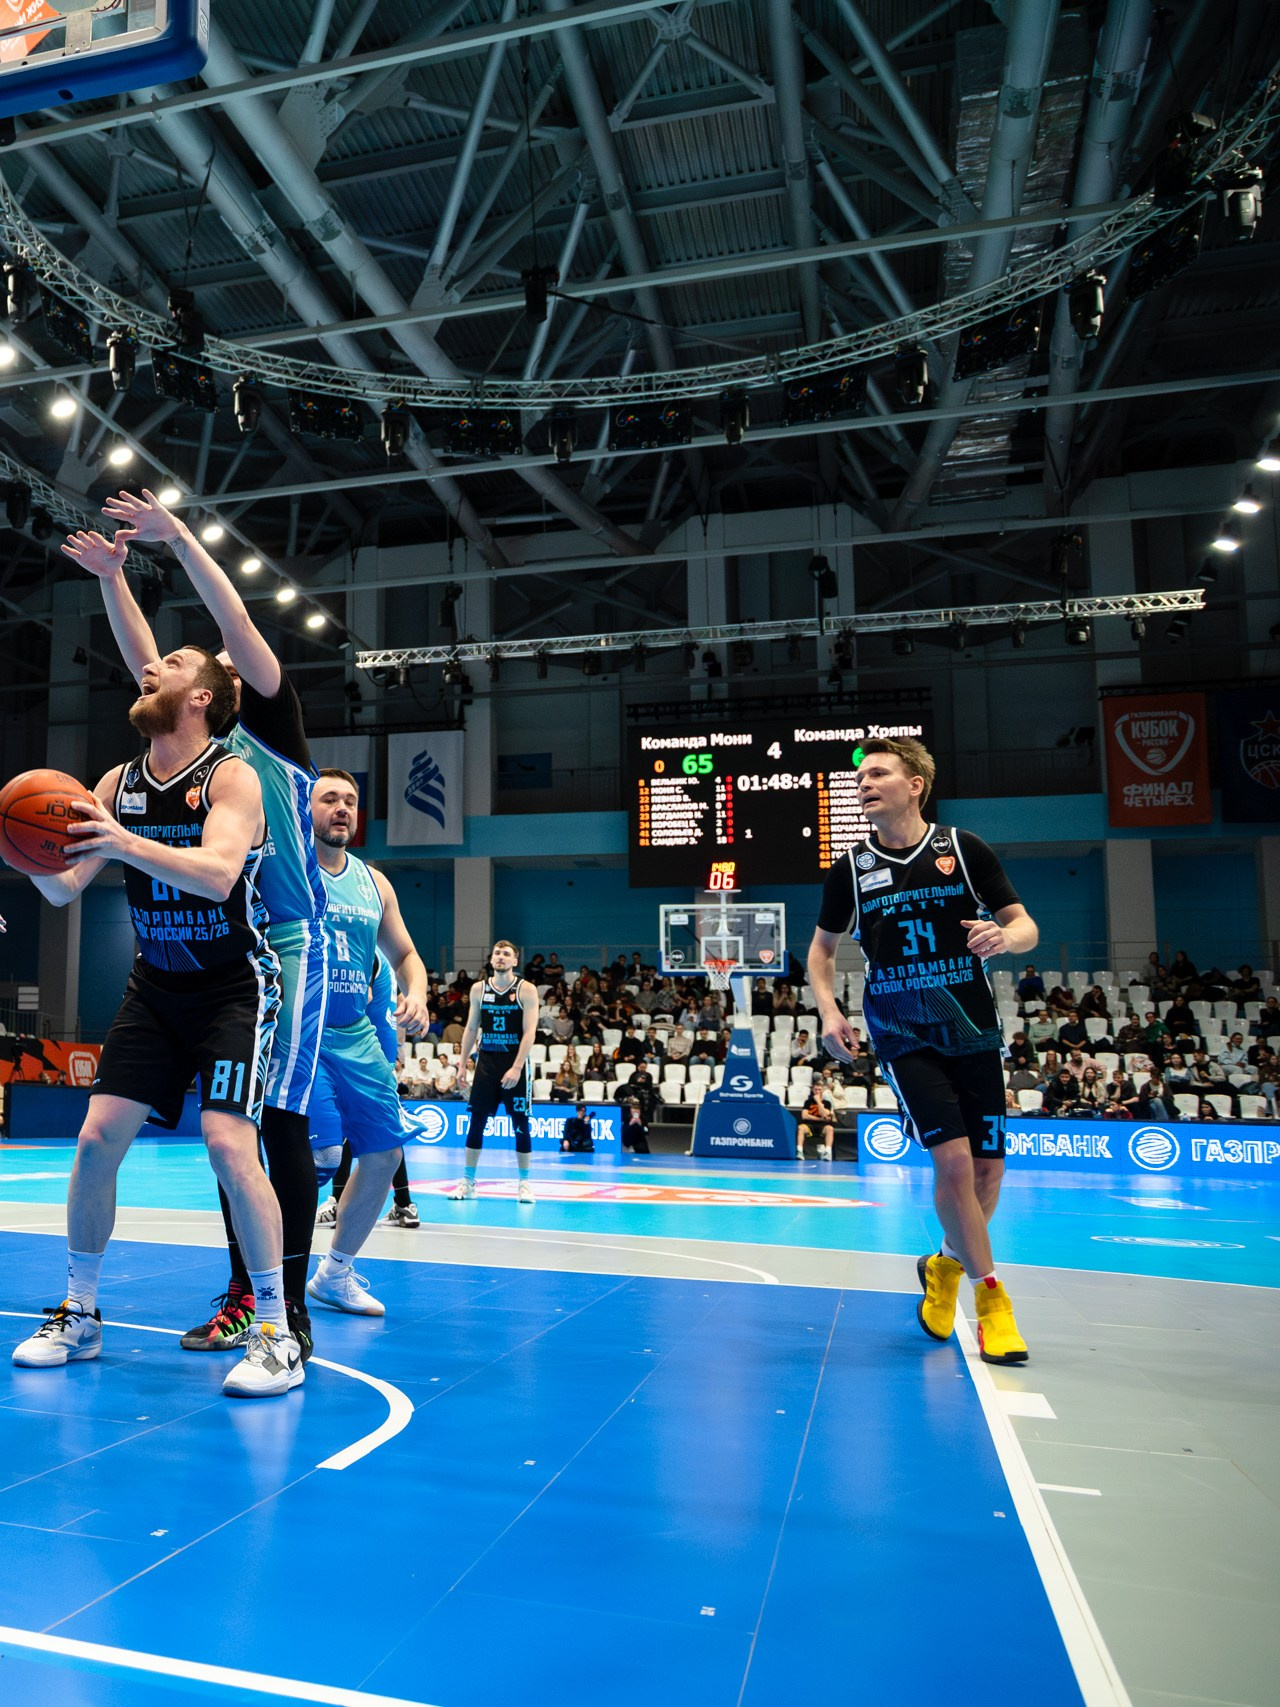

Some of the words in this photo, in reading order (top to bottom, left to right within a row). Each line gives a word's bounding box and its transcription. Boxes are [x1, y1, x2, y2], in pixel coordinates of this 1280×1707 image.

[794, 728, 864, 742] Команда
[867, 724, 922, 741] Хряпы
[1131, 719, 1179, 738] КУБОК
[641, 736, 706, 750] Команда
[710, 733, 752, 746] Мони
[767, 742, 782, 759] 4
[654, 760, 665, 773] 0
[682, 754, 713, 775] 65
[737, 772, 812, 792] 01:48:4
[1123, 782, 1194, 796] ФИНАЛ
[1123, 794, 1194, 808] ЧЕТЫРЕХ
[802, 827, 812, 837] 0
[709, 871, 734, 890] 06
[862, 883, 964, 914] БЛАГОТВОРИТЕЛЬНЫЙ
[881, 899, 945, 917] МАТЧ
[150, 926, 192, 940] РОССИИ
[194, 921, 230, 940] 25/26
[898, 919, 937, 957] 34
[335, 930, 350, 962] 8
[868, 956, 972, 982] ГАЗПРОМБАНК
[870, 980, 904, 995] КУБОК
[906, 975, 946, 993] РОССИИ
[493, 1016, 505, 1031] 23
[210, 1060, 245, 1103] 81
[513, 1097, 526, 1112] 23
[710, 1136, 774, 1148] ГАЗПРОМБАНК
